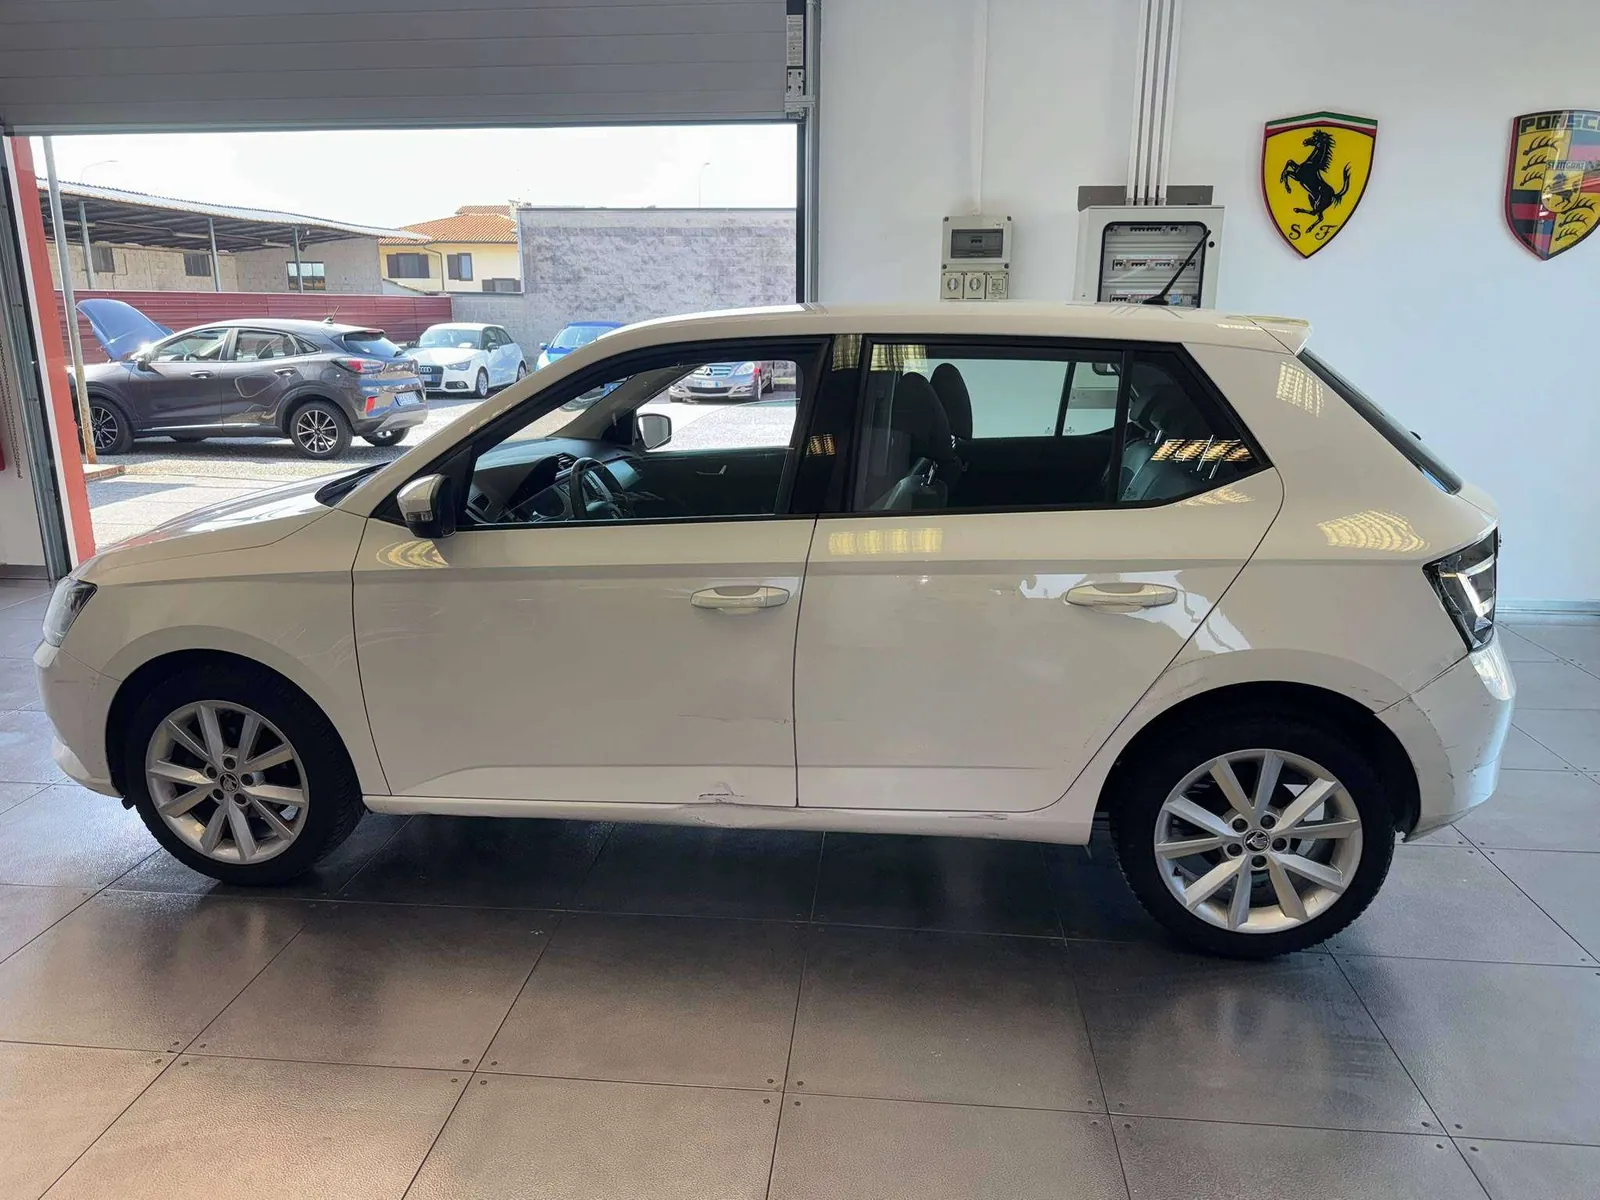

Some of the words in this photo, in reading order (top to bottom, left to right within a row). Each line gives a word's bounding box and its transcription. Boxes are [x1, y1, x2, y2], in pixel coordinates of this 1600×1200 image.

[1520, 113, 1600, 134] PORSC
[1289, 224, 1301, 240] S
[1315, 225, 1337, 240] F
